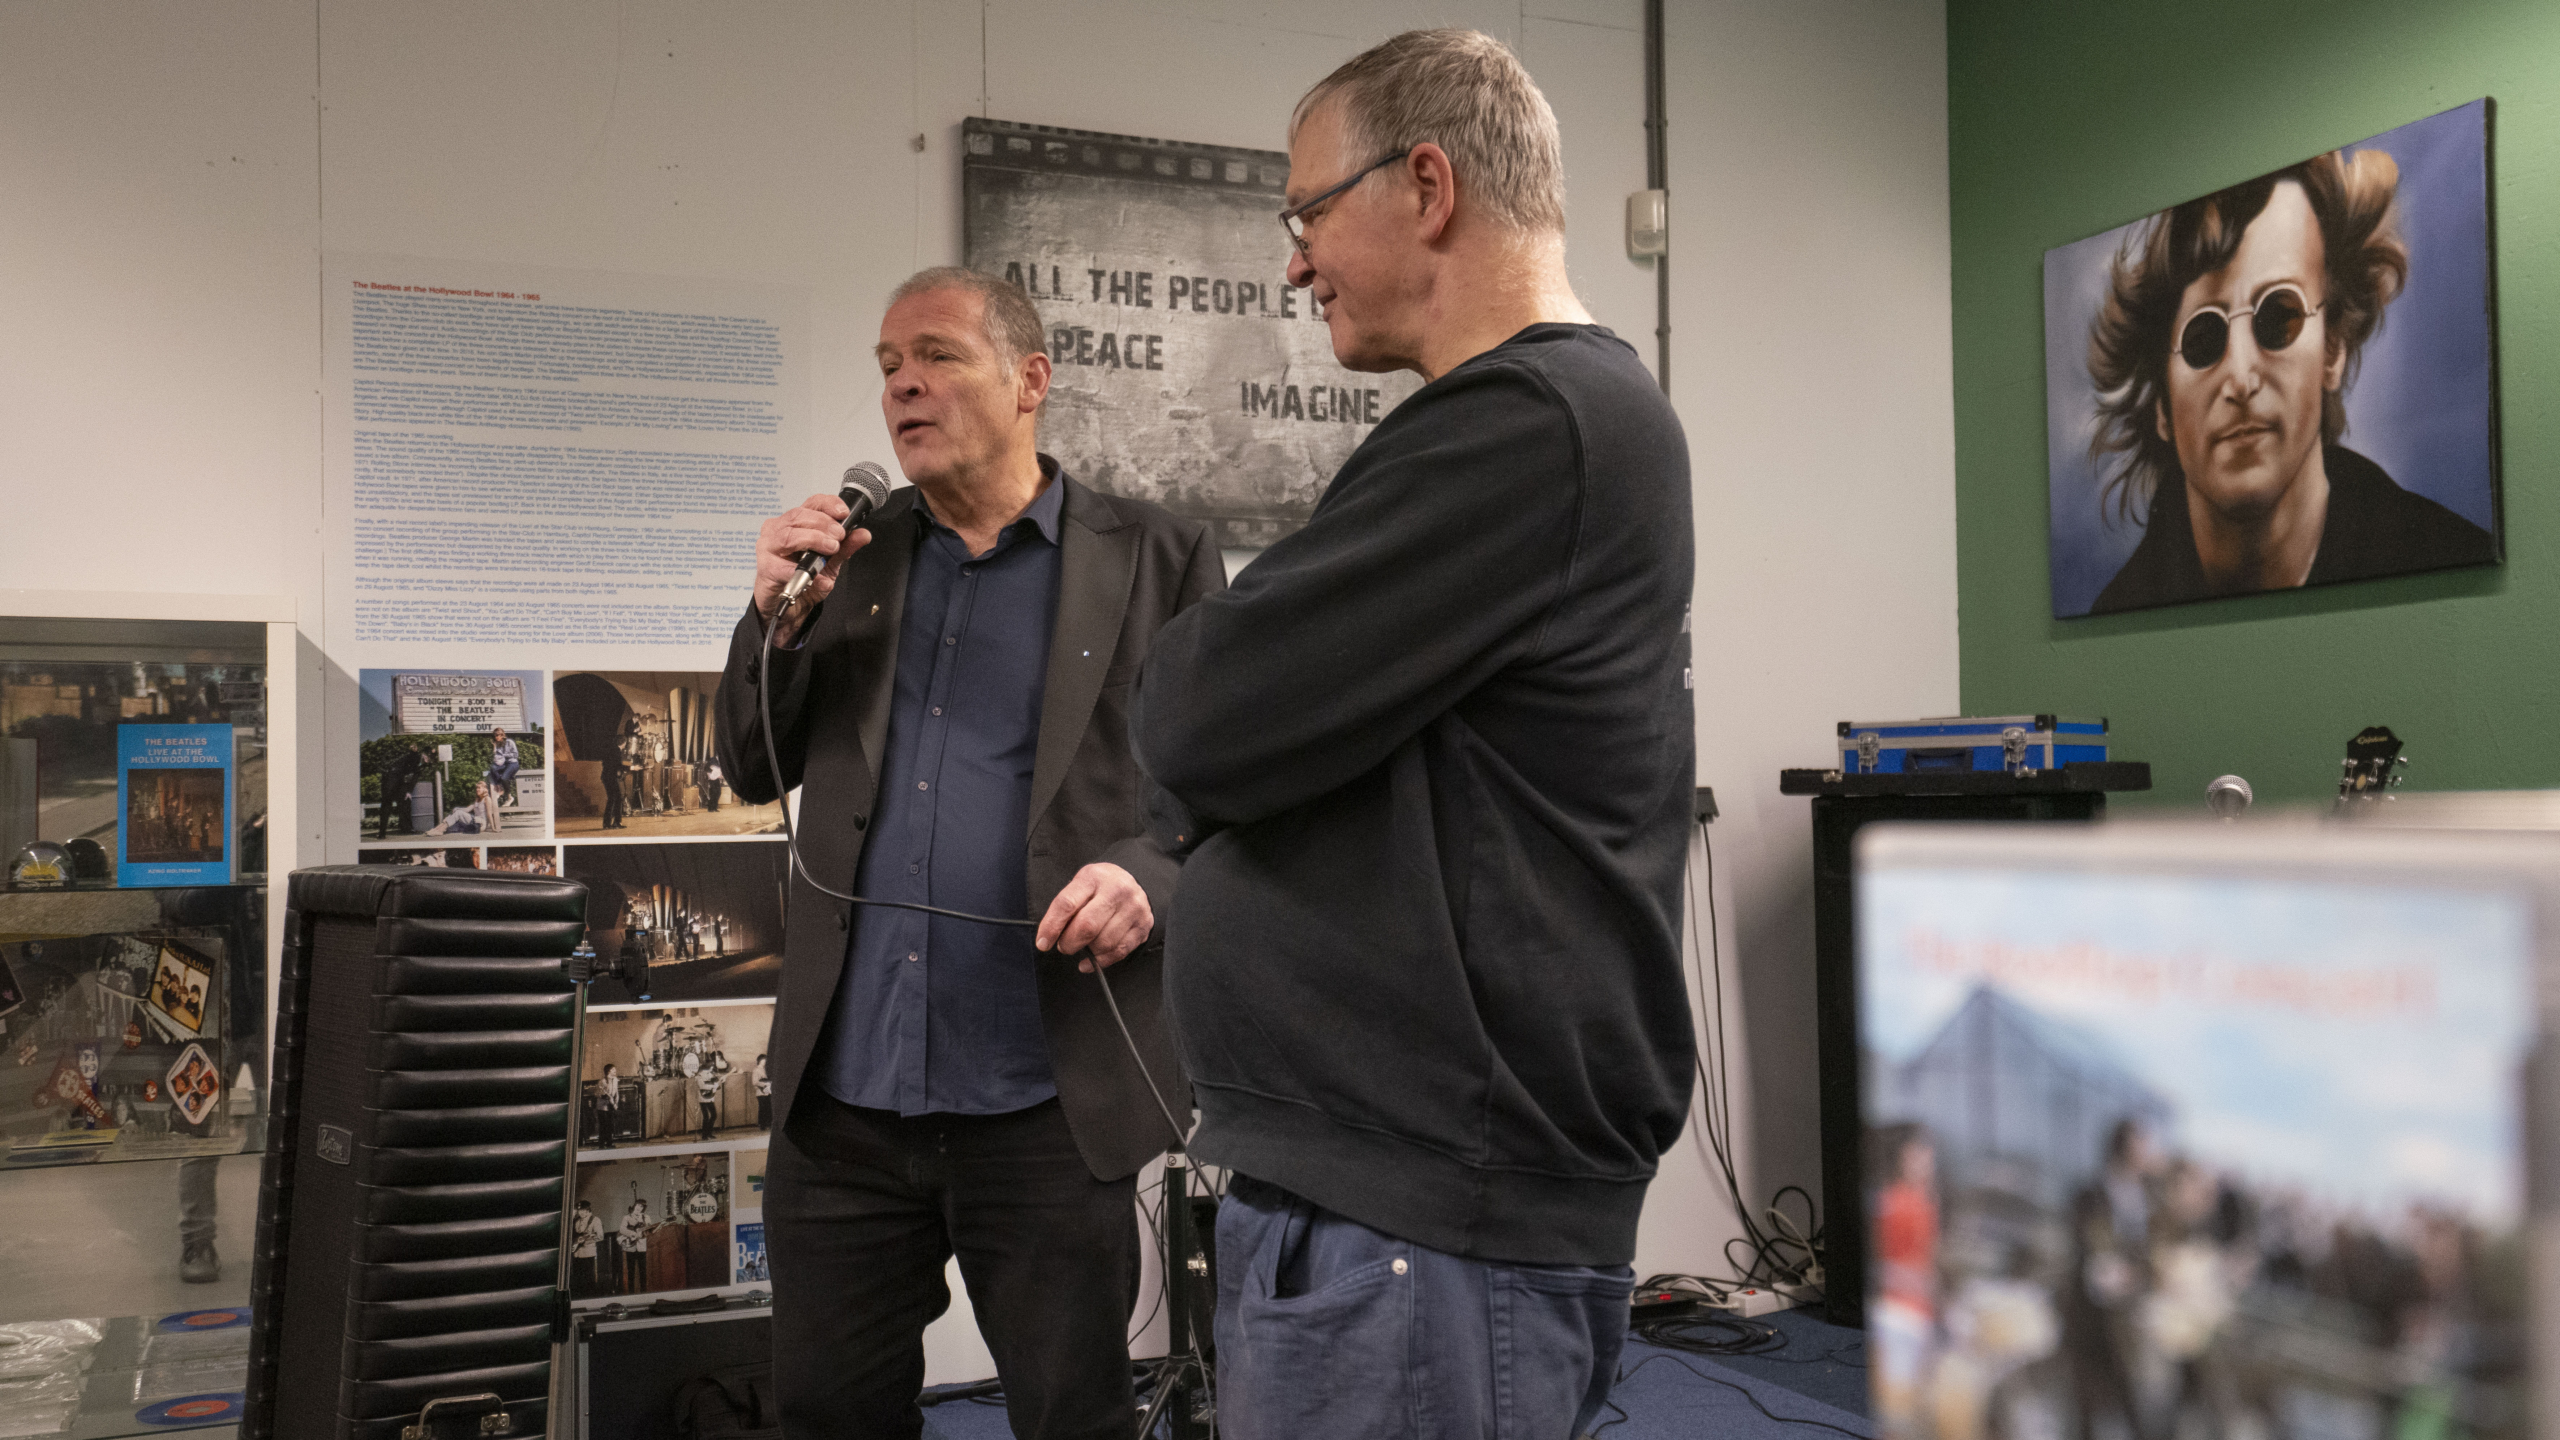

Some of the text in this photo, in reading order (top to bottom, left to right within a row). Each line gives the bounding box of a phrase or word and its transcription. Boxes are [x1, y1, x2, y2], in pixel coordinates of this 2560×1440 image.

[353, 281, 369, 289] The
[370, 282, 401, 291] Beatles
[428, 286, 472, 297] Hollywood
[474, 290, 494, 298] Bowl
[1005, 262, 1073, 301] ALL
[1087, 268, 1153, 308] THE
[1169, 275, 1297, 319] PEOPLE
[1053, 329, 1163, 371] PEACE
[1242, 381, 1380, 424] IMAGINE
[400, 676, 518, 688] HOLLYWOOD BOWL
[459, 706, 495, 714] BEATLES
[476, 723, 493, 731] OUT
[145, 738, 207, 746] THE BEATLES
[148, 748, 203, 756] LIVE AT THE
[131, 756, 190, 764] HOLLYWOOD
[690, 1204, 715, 1216] BEATLES
